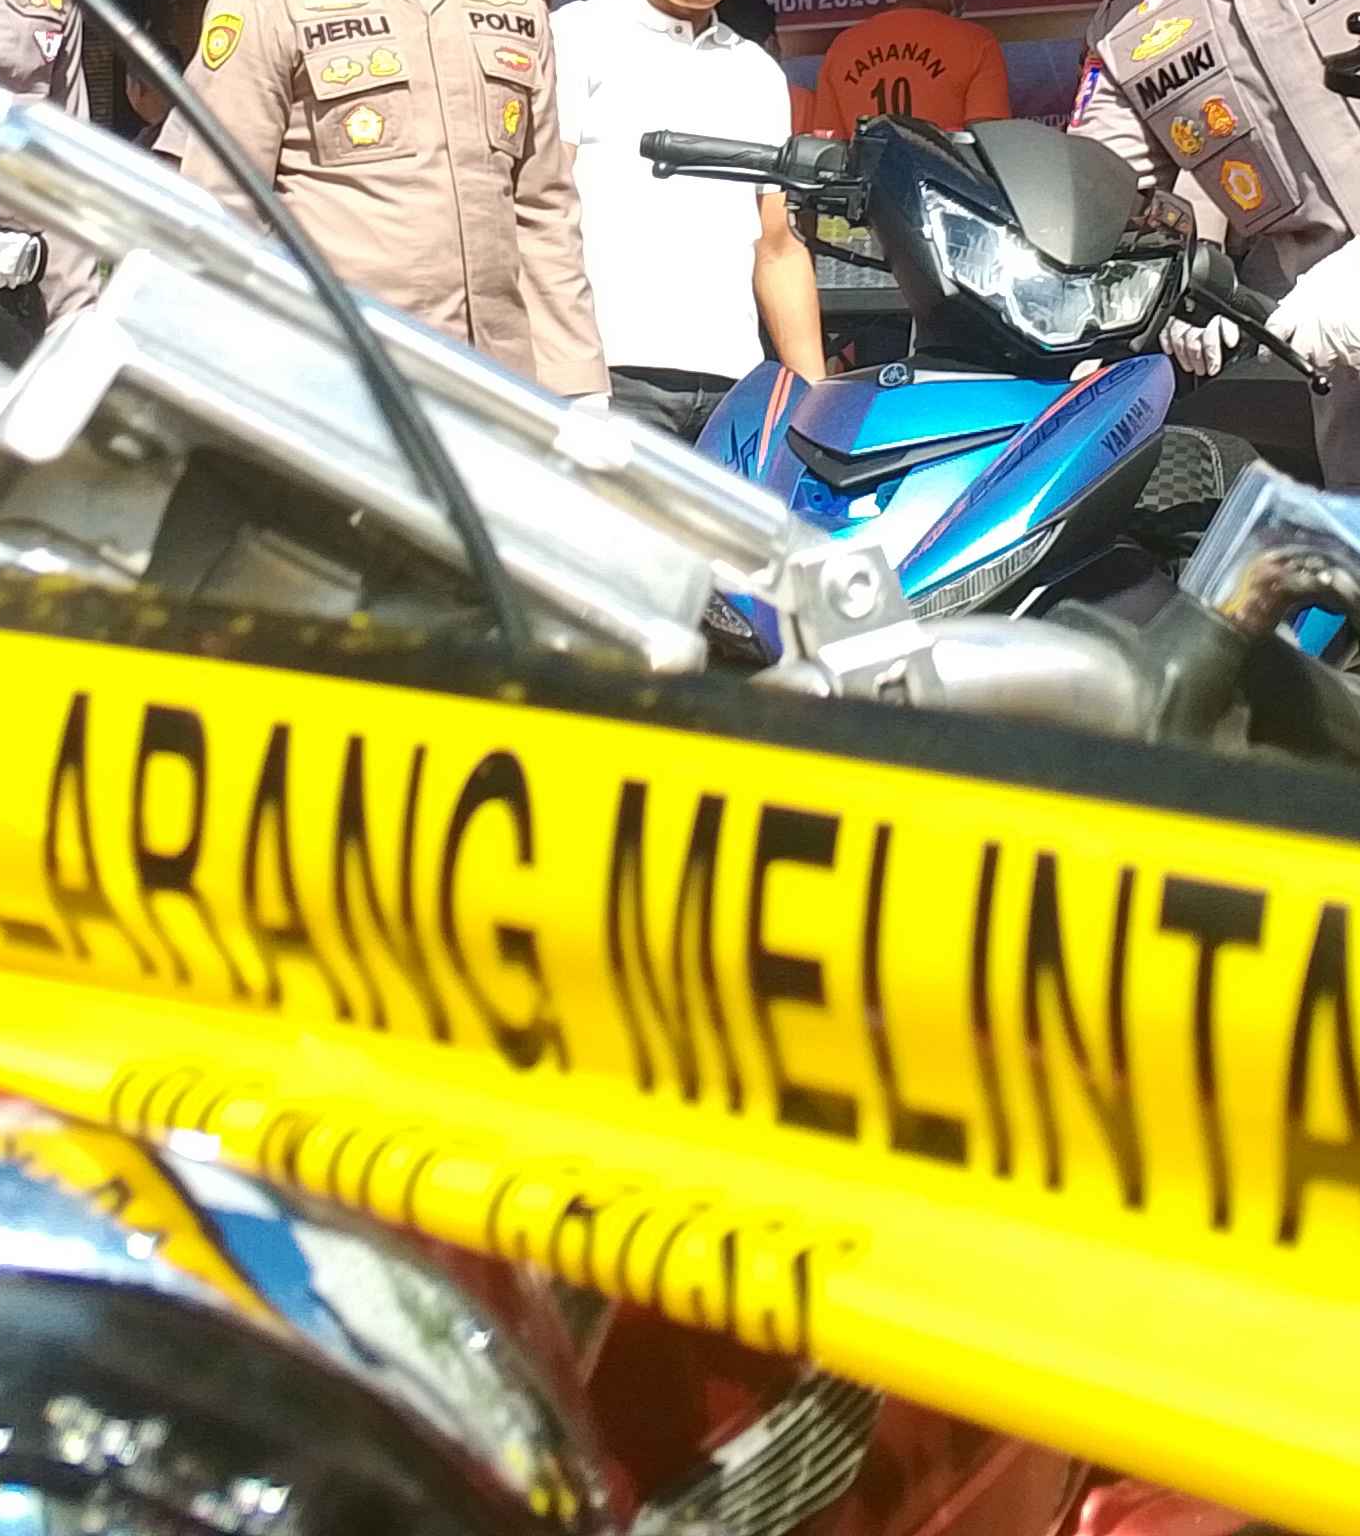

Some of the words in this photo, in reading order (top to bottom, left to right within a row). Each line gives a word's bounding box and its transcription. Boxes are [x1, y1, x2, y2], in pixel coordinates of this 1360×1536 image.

[303, 14, 391, 50] HERLI
[469, 11, 536, 40] POLRI
[844, 43, 947, 85] TAHANAN
[1134, 42, 1216, 111] MALIKI
[870, 76, 913, 118] 10
[1100, 396, 1156, 459] YAMAHA
